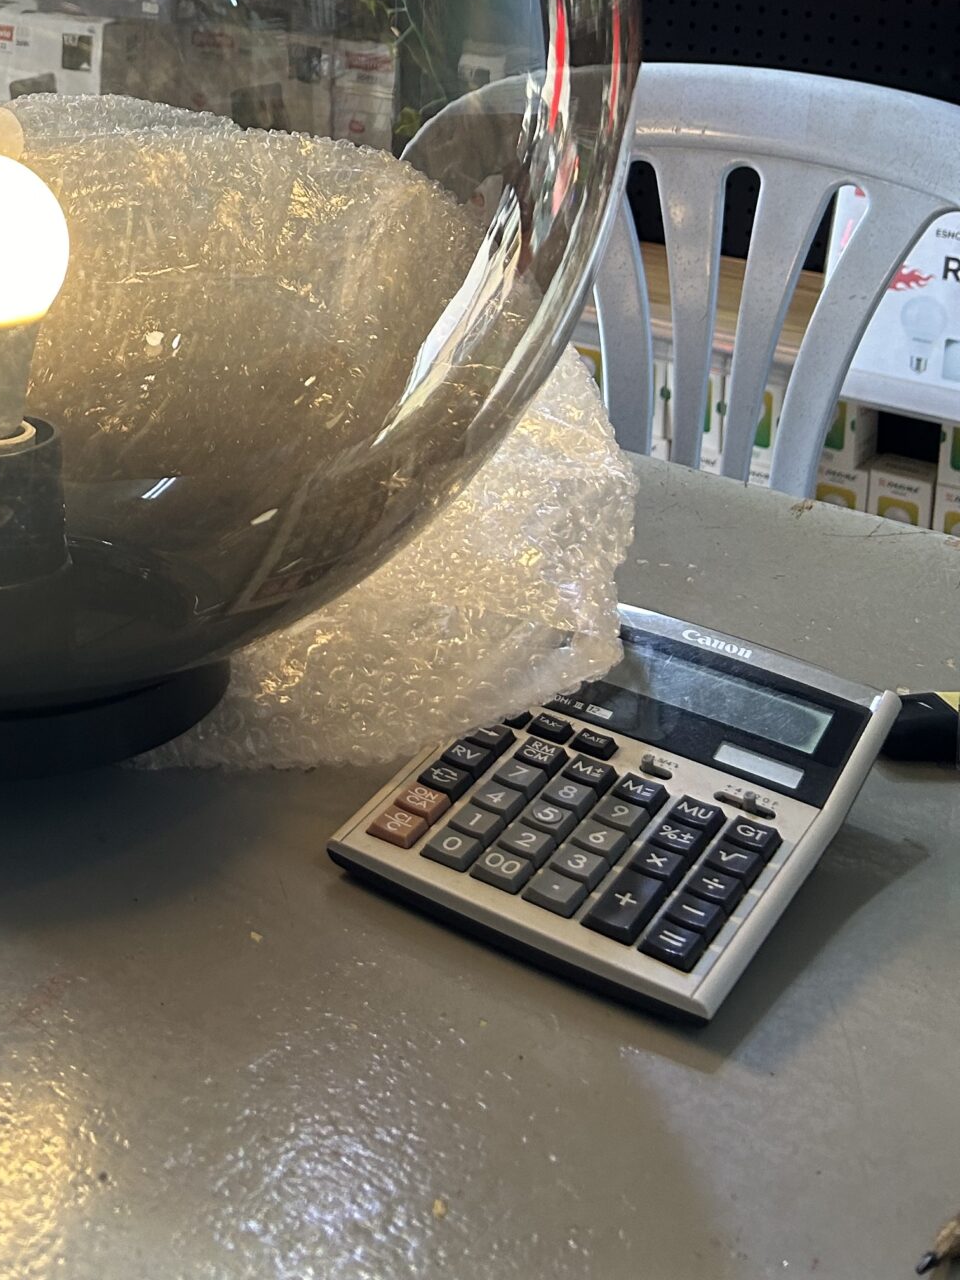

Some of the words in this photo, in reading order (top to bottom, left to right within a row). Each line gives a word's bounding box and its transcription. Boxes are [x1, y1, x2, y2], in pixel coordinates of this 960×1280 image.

[942, 256, 960, 282] R
[681, 629, 754, 660] Canon
[582, 732, 607, 745] RATE
[451, 744, 481, 761] RV
[531, 740, 556, 755] RM
[524, 748, 549, 763] CM
[509, 765, 530, 778] 7
[412, 786, 438, 801] ON
[486, 791, 506, 804] 4
[558, 785, 578, 799] 8
[406, 795, 428, 810] CA
[537, 807, 559, 822] 5
[610, 805, 630, 818] 9
[677, 802, 714, 820] MU
[468, 812, 483, 826] 1
[514, 832, 537, 848] 2
[588, 829, 609, 844] 6
[736, 824, 768, 841] GT
[442, 836, 462, 852] 0
[484, 852, 521, 874] 00
[567, 853, 588, 869] 3
